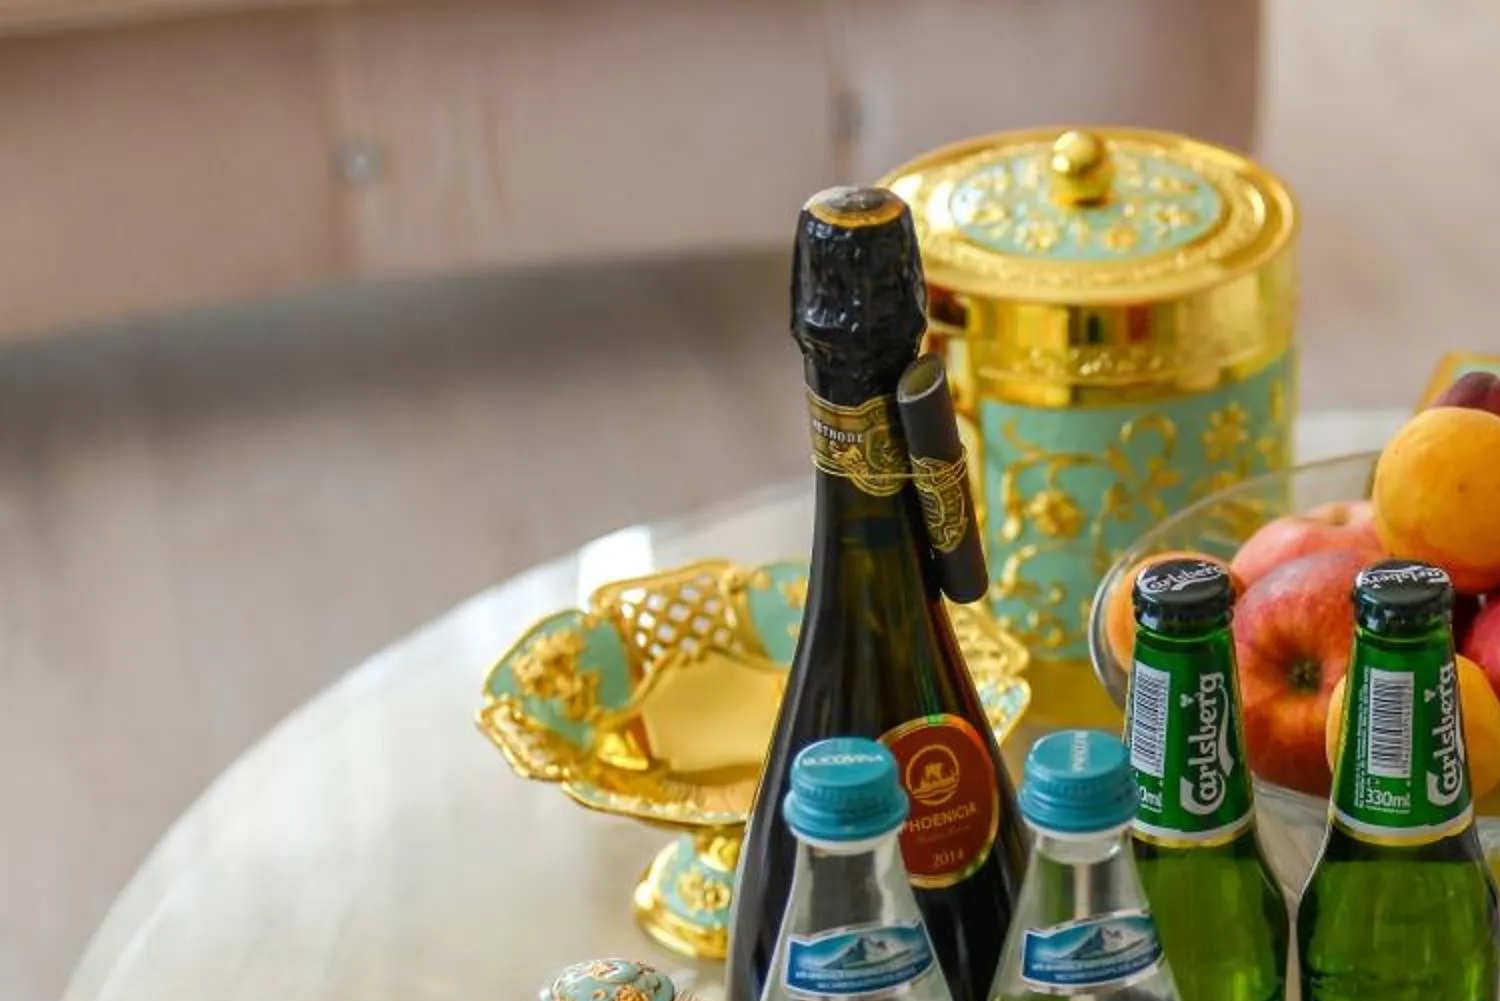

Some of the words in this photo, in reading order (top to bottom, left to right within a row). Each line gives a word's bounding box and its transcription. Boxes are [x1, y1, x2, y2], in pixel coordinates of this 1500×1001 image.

[1137, 564, 1228, 593] Carlsberg
[1180, 672, 1234, 814] Carlsberg
[1427, 664, 1464, 806] Carlsberg
[1365, 788, 1411, 809] 330ml
[904, 802, 978, 832] HOENICIA
